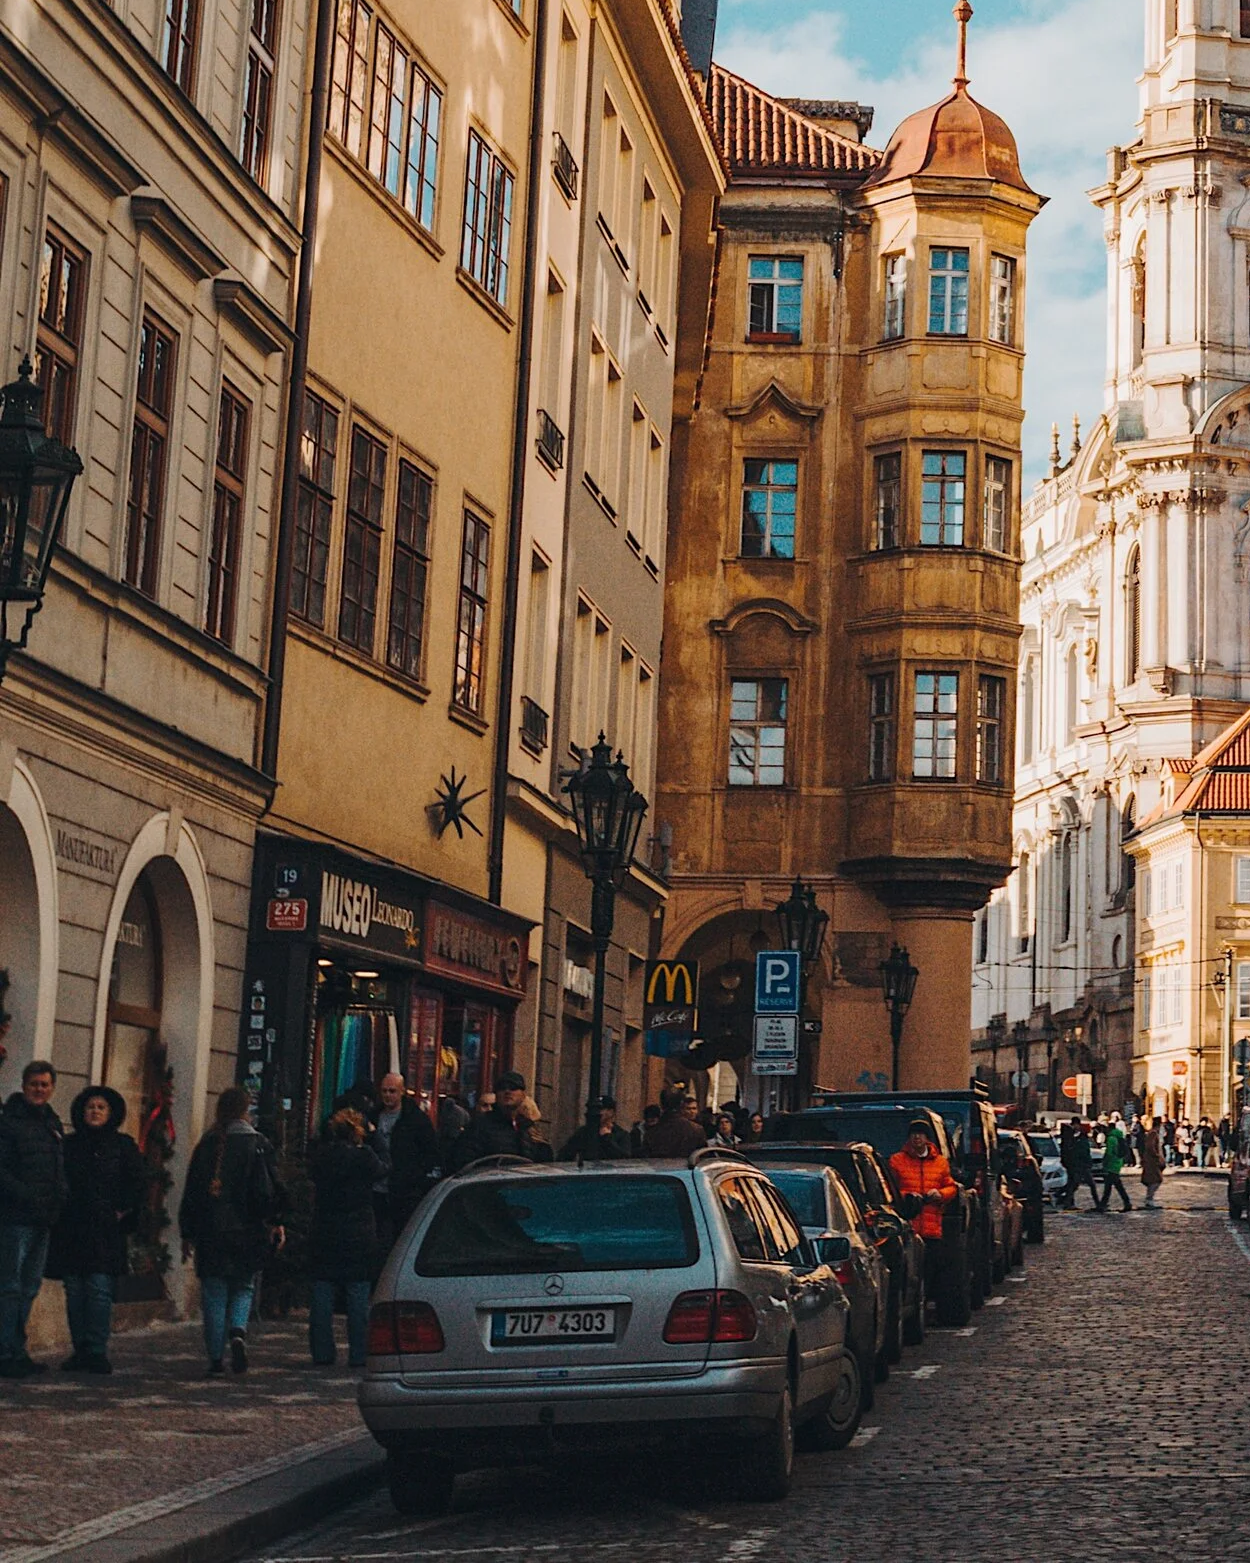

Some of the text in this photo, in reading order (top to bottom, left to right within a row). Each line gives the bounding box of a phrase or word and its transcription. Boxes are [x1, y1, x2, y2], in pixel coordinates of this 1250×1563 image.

[283, 869, 297, 883] 19
[274, 902, 300, 916] 275
[320, 870, 371, 938] MUSEO
[765, 959, 790, 994] P
[509, 1312, 606, 1334] 7U7 4303
